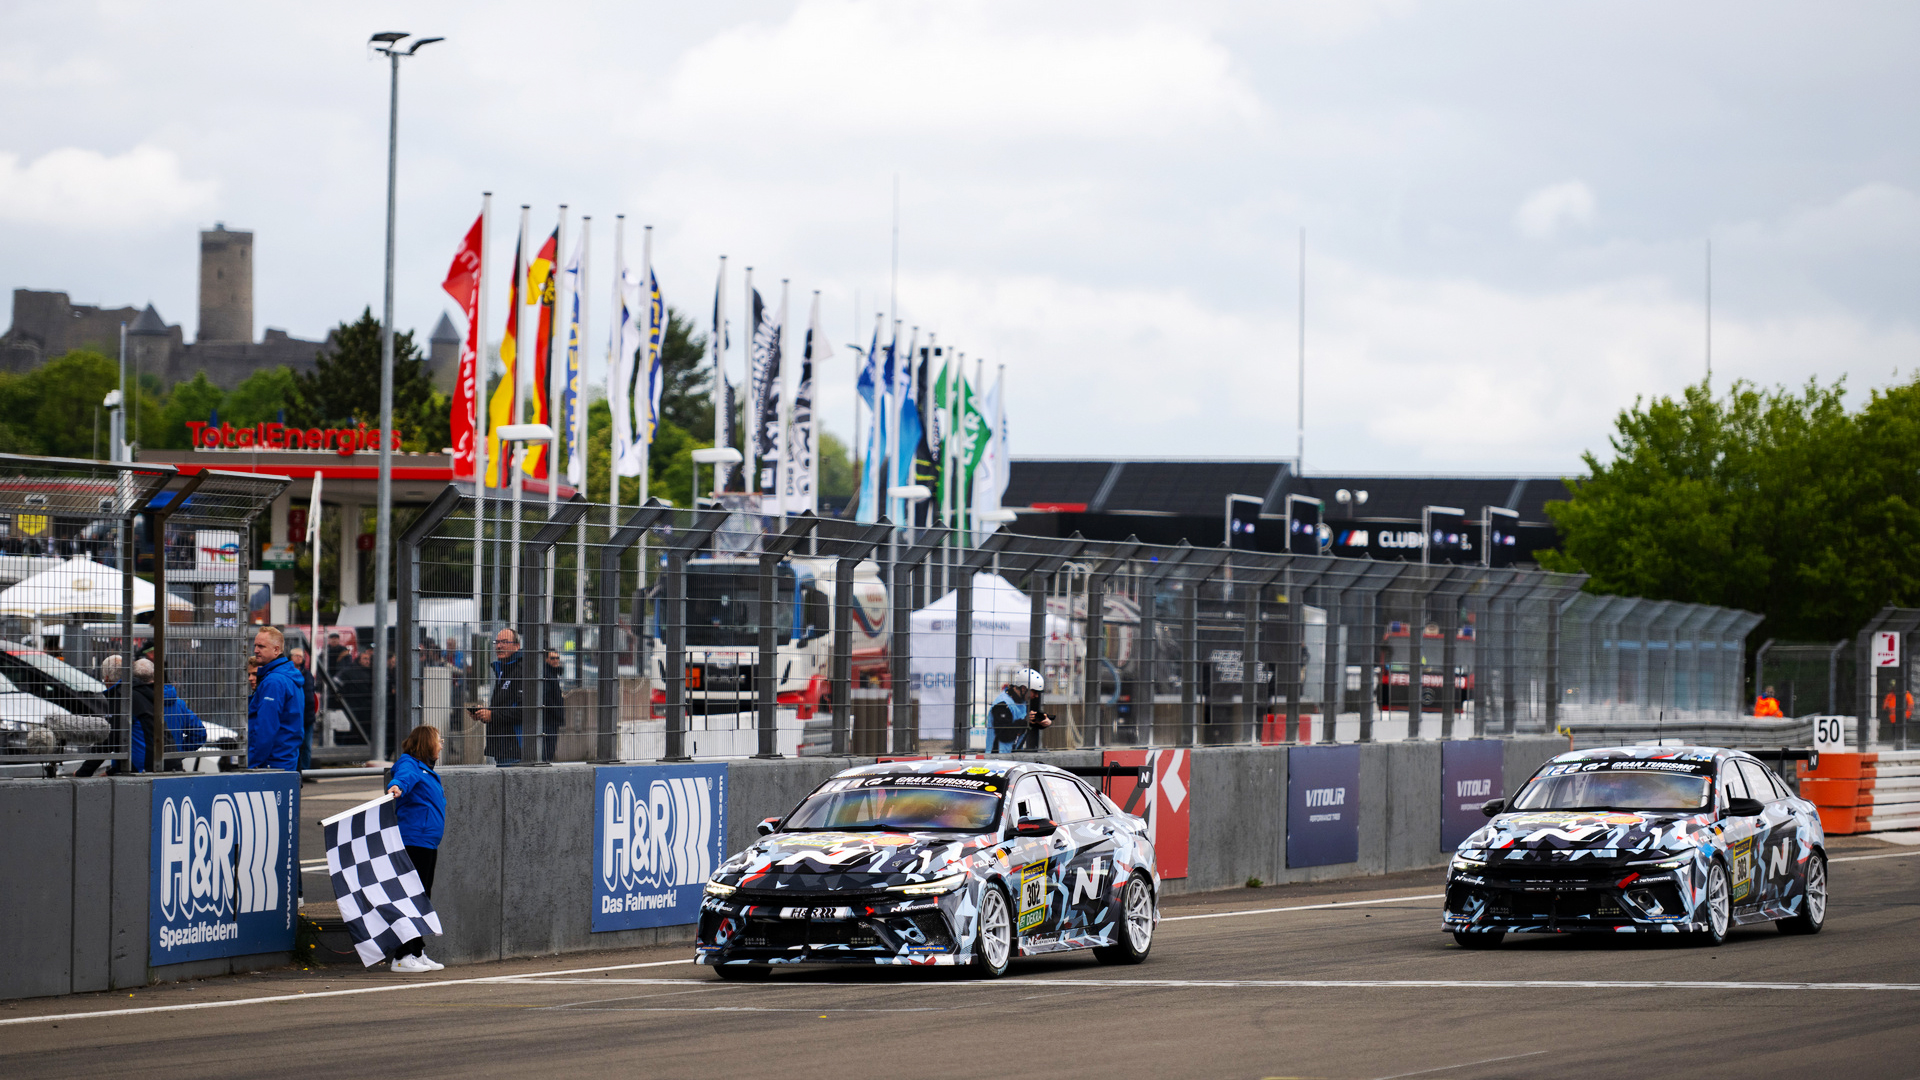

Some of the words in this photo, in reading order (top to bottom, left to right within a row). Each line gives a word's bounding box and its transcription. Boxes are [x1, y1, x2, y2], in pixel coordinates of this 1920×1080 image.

[186, 421, 402, 456] TotalEnergies
[1818, 719, 1840, 743] 50
[1140, 770, 1149, 783] N
[1644, 762, 1696, 770] TURISMO
[930, 777, 984, 787] TURISMO
[1457, 779, 1491, 797] VITOUR
[1306, 787, 1345, 807] VITOUR
[601, 780, 676, 892] H&R
[161, 793, 240, 922] H&R
[286, 788, 294, 930] www.h-r.com
[601, 895, 623, 913] Das
[625, 890, 677, 912] Fahrwerk!
[1026, 880, 1041, 908] 302
[1026, 909, 1043, 928] DEKRA
[159, 920, 238, 951] Spezialfedern
